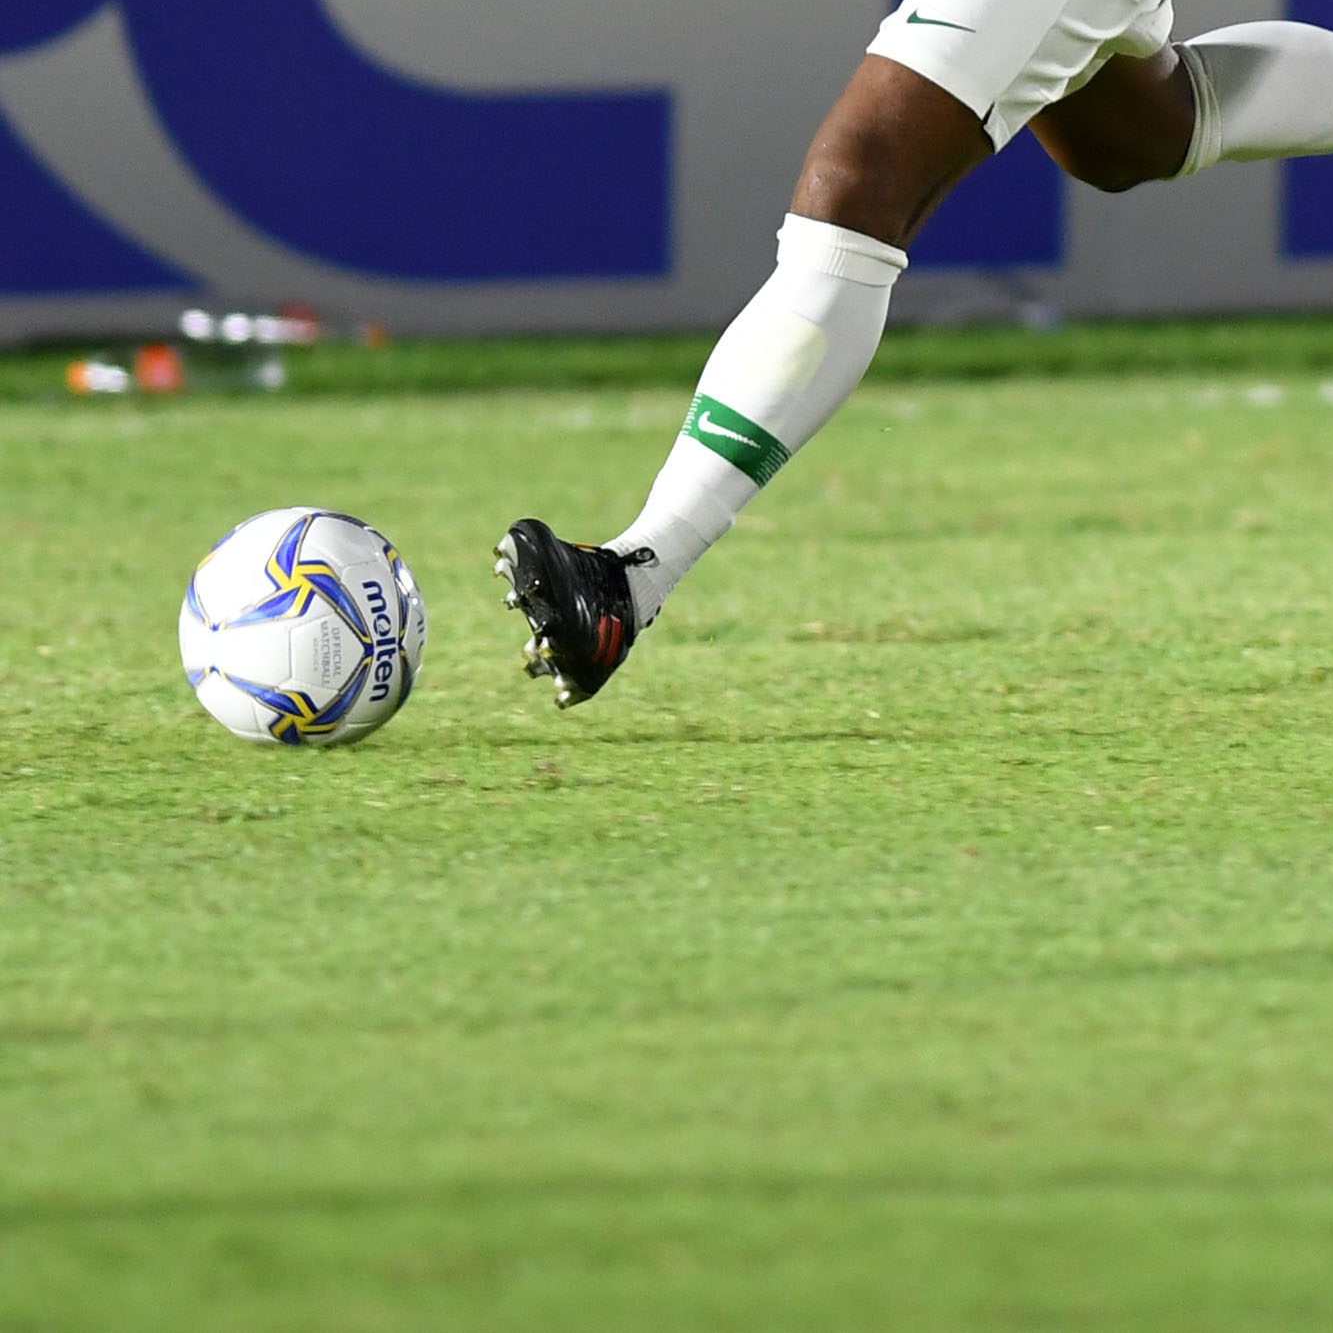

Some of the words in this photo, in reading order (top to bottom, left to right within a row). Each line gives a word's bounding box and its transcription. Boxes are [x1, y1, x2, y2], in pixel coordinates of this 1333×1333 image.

[320, 619, 331, 687] MATCHBALL
[331, 626, 342, 679] OFFICIAL
[362, 580, 398, 702] molten
